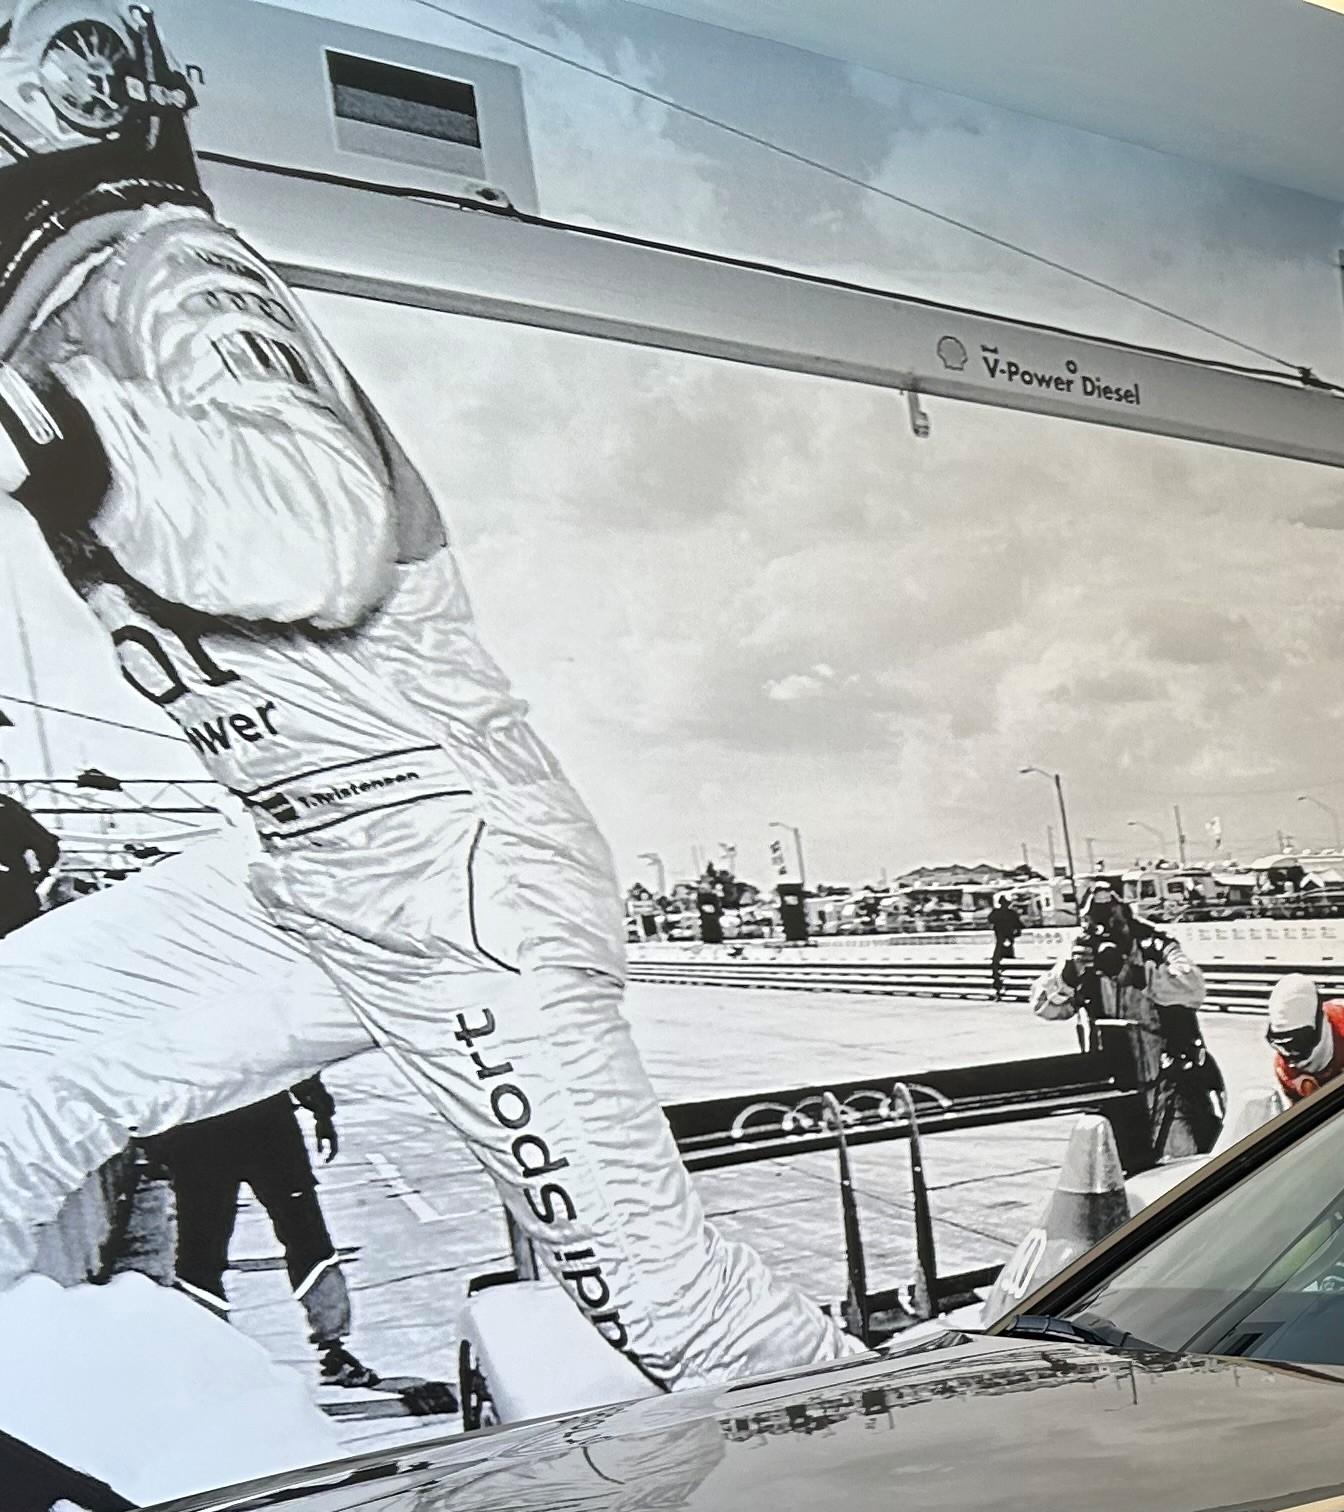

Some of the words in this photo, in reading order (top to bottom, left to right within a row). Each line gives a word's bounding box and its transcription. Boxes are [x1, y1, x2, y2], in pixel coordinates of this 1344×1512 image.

[980, 345, 1074, 391] V-Power
[1081, 374, 1141, 405] Diesel
[454, 1008, 577, 1224] Sport
